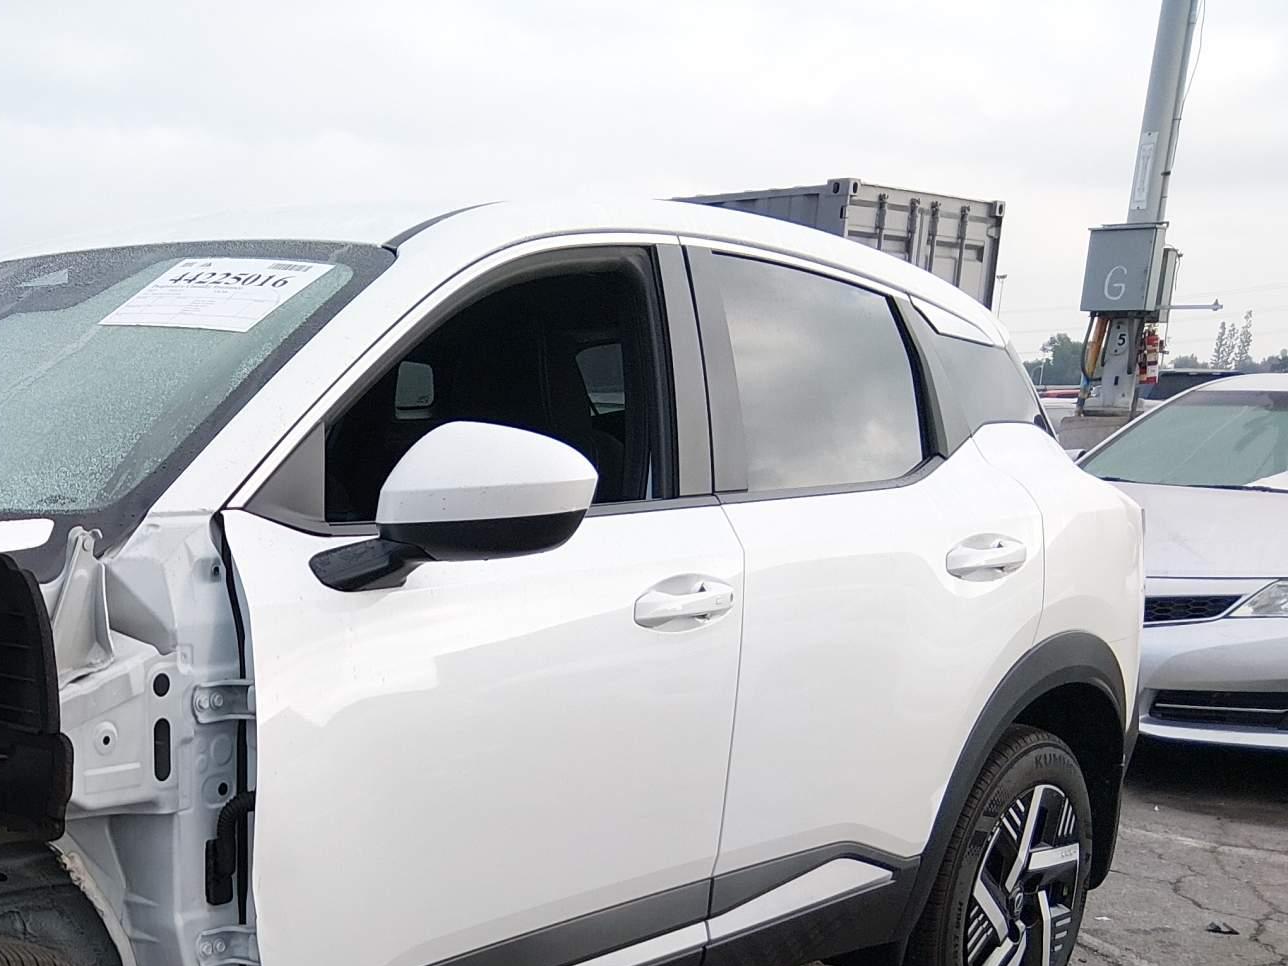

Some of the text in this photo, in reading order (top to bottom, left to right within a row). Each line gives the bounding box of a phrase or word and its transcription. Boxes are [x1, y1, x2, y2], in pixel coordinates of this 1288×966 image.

[170, 271, 295, 288] 44225016
[1103, 265, 1128, 300] G
[1117, 333, 1127, 346] 5
